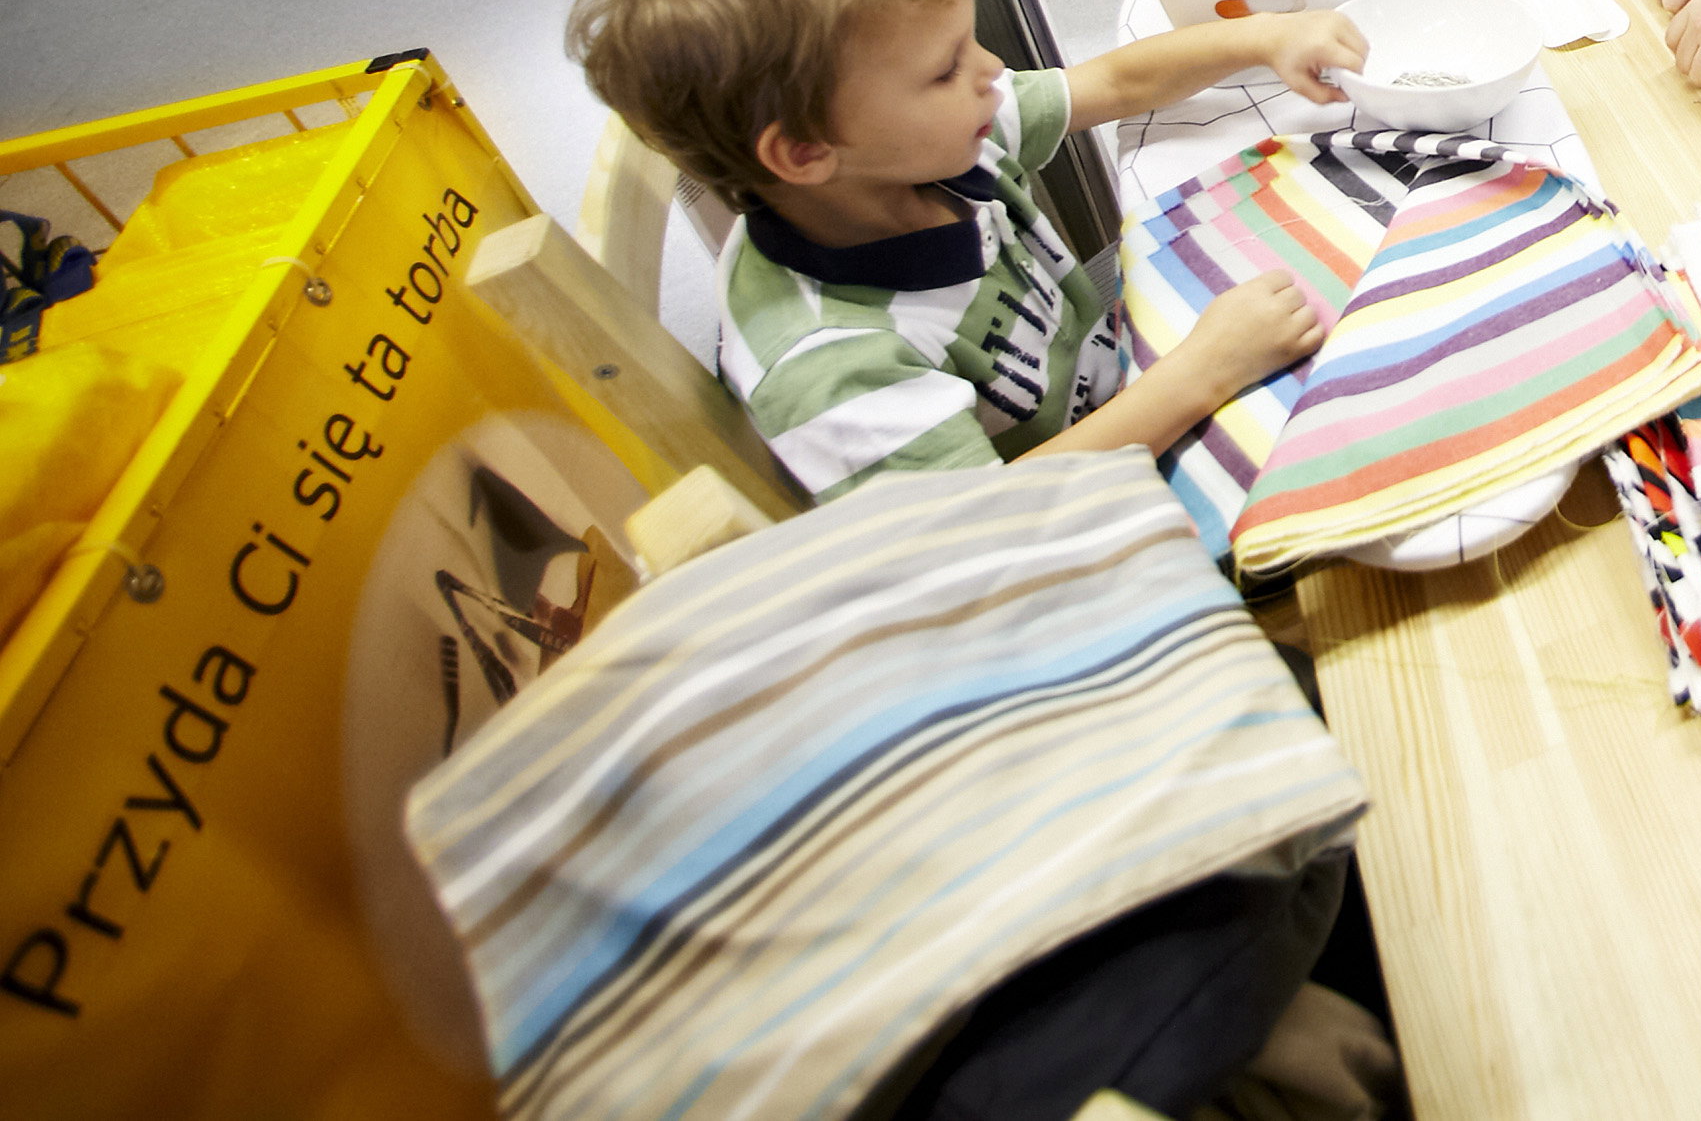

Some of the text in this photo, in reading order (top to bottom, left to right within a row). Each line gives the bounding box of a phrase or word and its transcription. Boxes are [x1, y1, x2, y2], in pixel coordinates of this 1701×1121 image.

[2, 185, 479, 1019] Przyda Ci się ta torba
